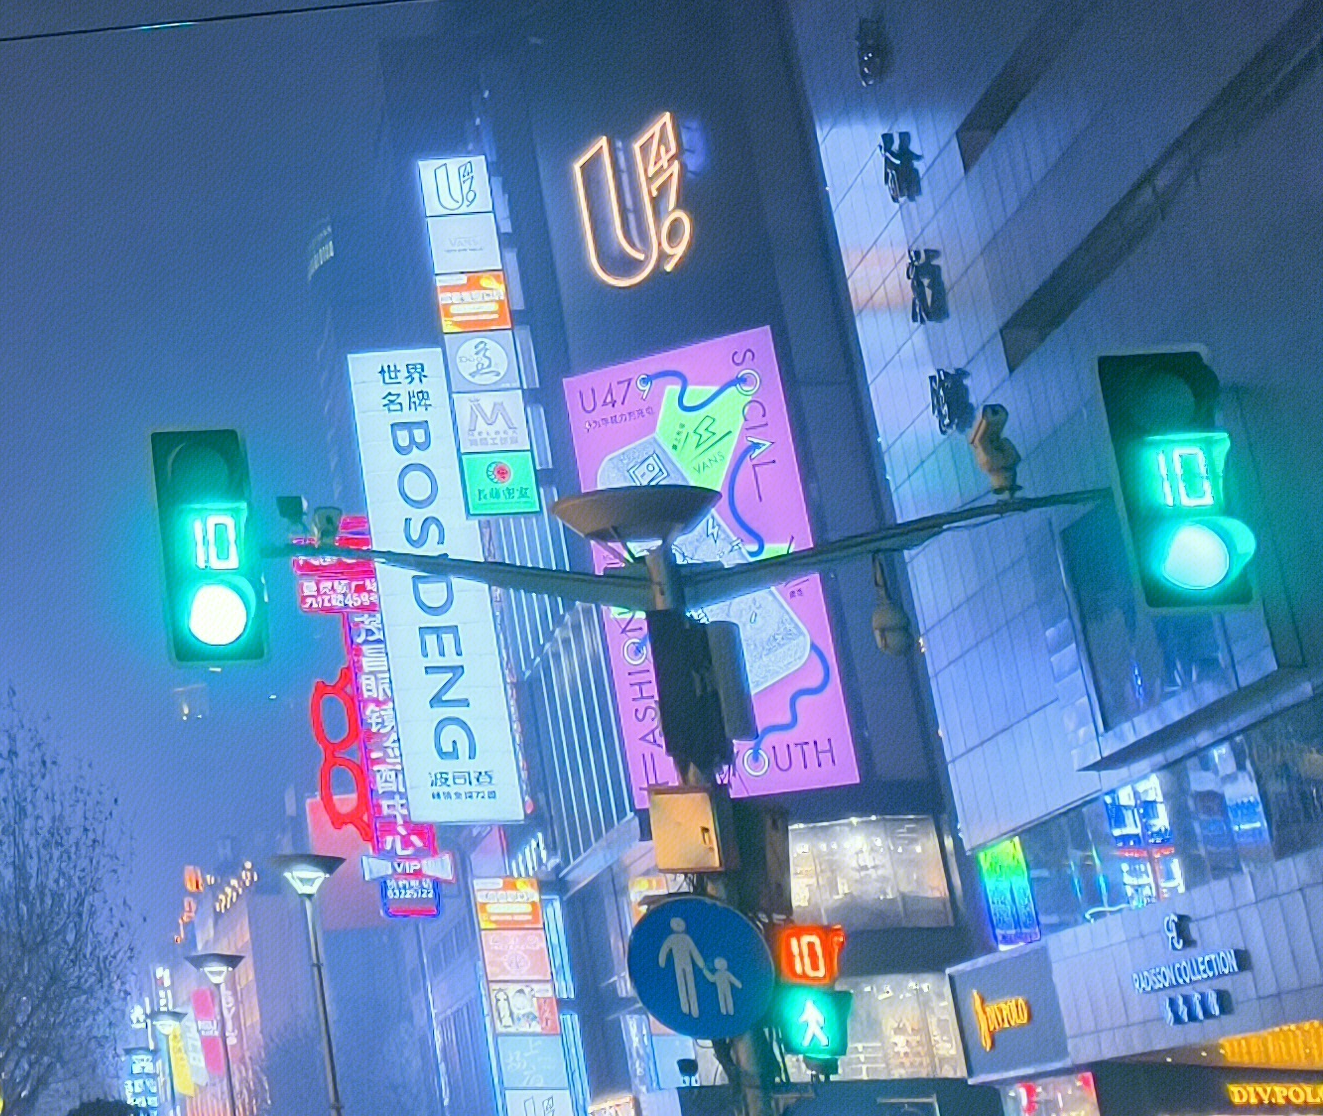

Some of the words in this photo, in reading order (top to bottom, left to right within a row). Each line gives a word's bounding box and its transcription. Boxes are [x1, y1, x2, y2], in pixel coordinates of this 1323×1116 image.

[379, 363, 428, 385] 世界
[578, 373, 653, 414] U479
[382, 391, 432, 413] 名牌
[693, 451, 725, 474] VANS
[1158, 447, 1215, 507] 10
[193, 514, 240, 570] 10
[390, 419, 477, 761] BOSDENG
[429, 770, 494, 787] 波司登
[394, 861, 421, 874] VIP
[790, 935, 825, 978] 10
[1132, 965, 1175, 995] RADISSON
[1175, 949, 1239, 986] COLLECTION
